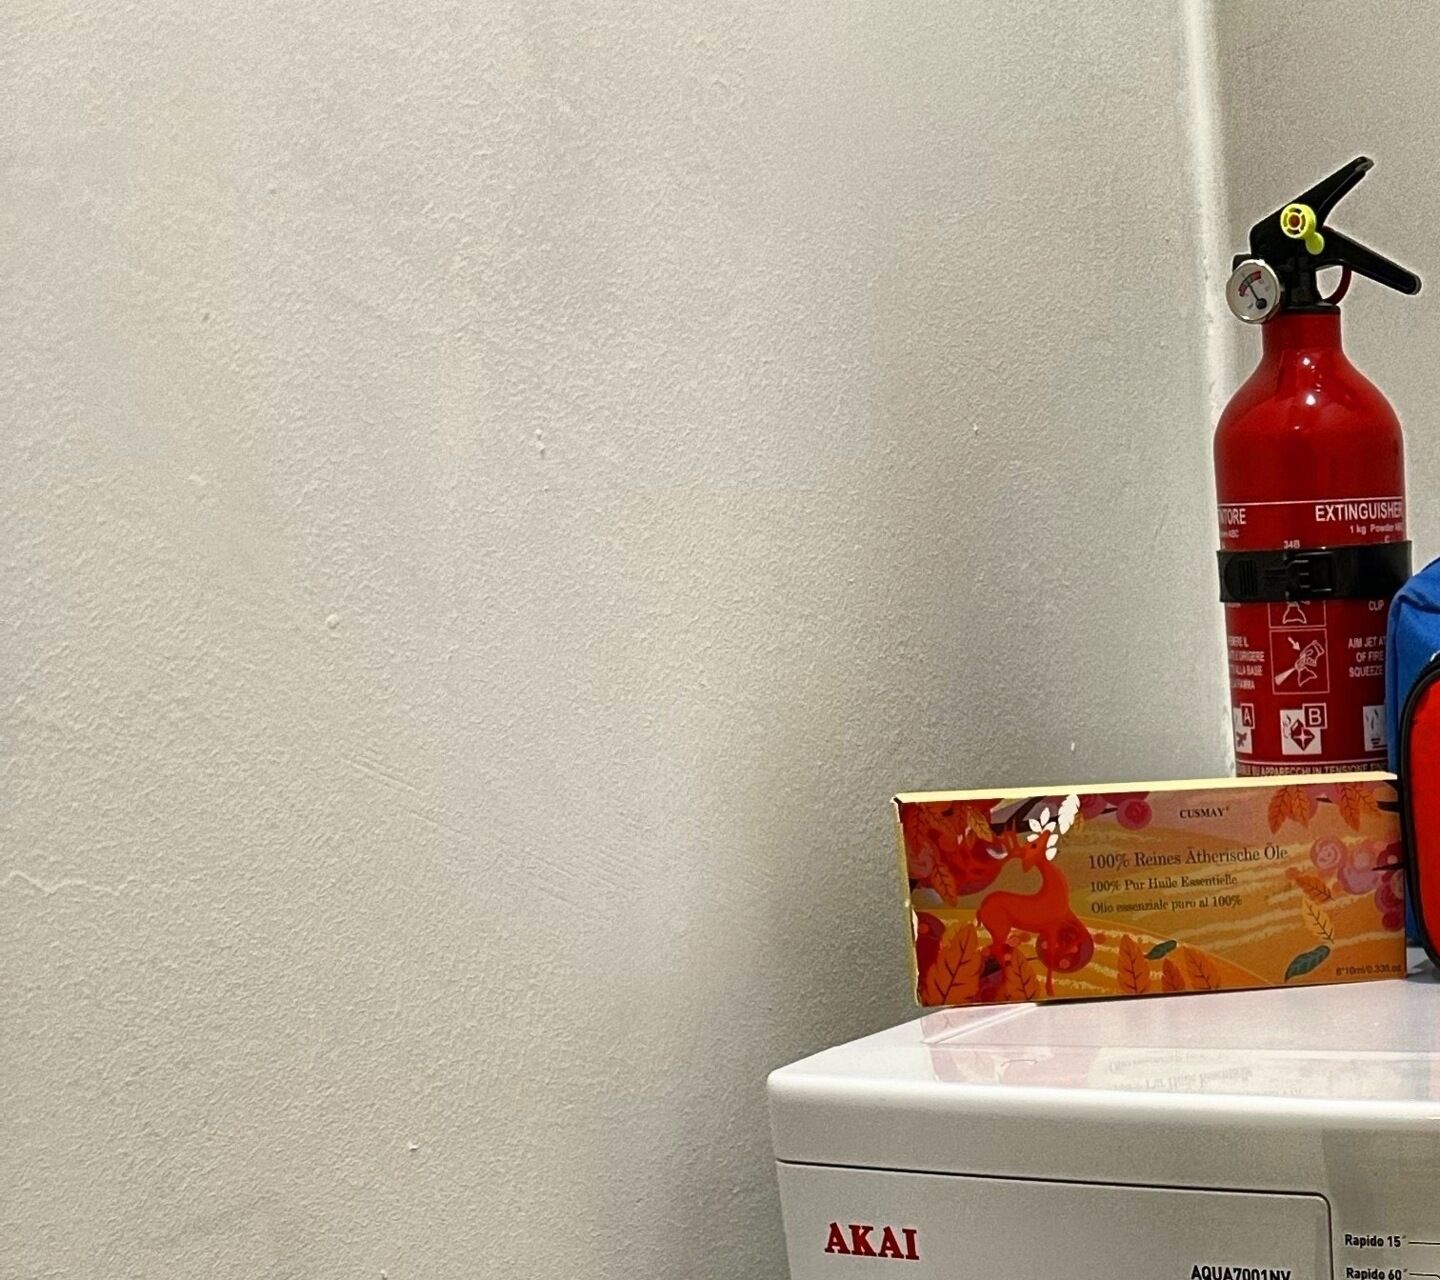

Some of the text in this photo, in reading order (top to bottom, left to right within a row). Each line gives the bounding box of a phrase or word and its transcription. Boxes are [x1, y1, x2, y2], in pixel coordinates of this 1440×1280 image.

[1308, 708, 1322, 726] B
[1088, 852, 1130, 870] 100%
[1134, 851, 1181, 868] Reines
[1090, 873, 1239, 893] 100% Pur Huile Essentielle
[1091, 901, 1114, 914] Olio
[1116, 898, 1169, 912] essenziale
[1172, 899, 1196, 912] puro
[1212, 894, 1243, 907] 100%
[824, 1222, 920, 1260] AKAI
[1345, 1234, 1384, 1249] Rapido
